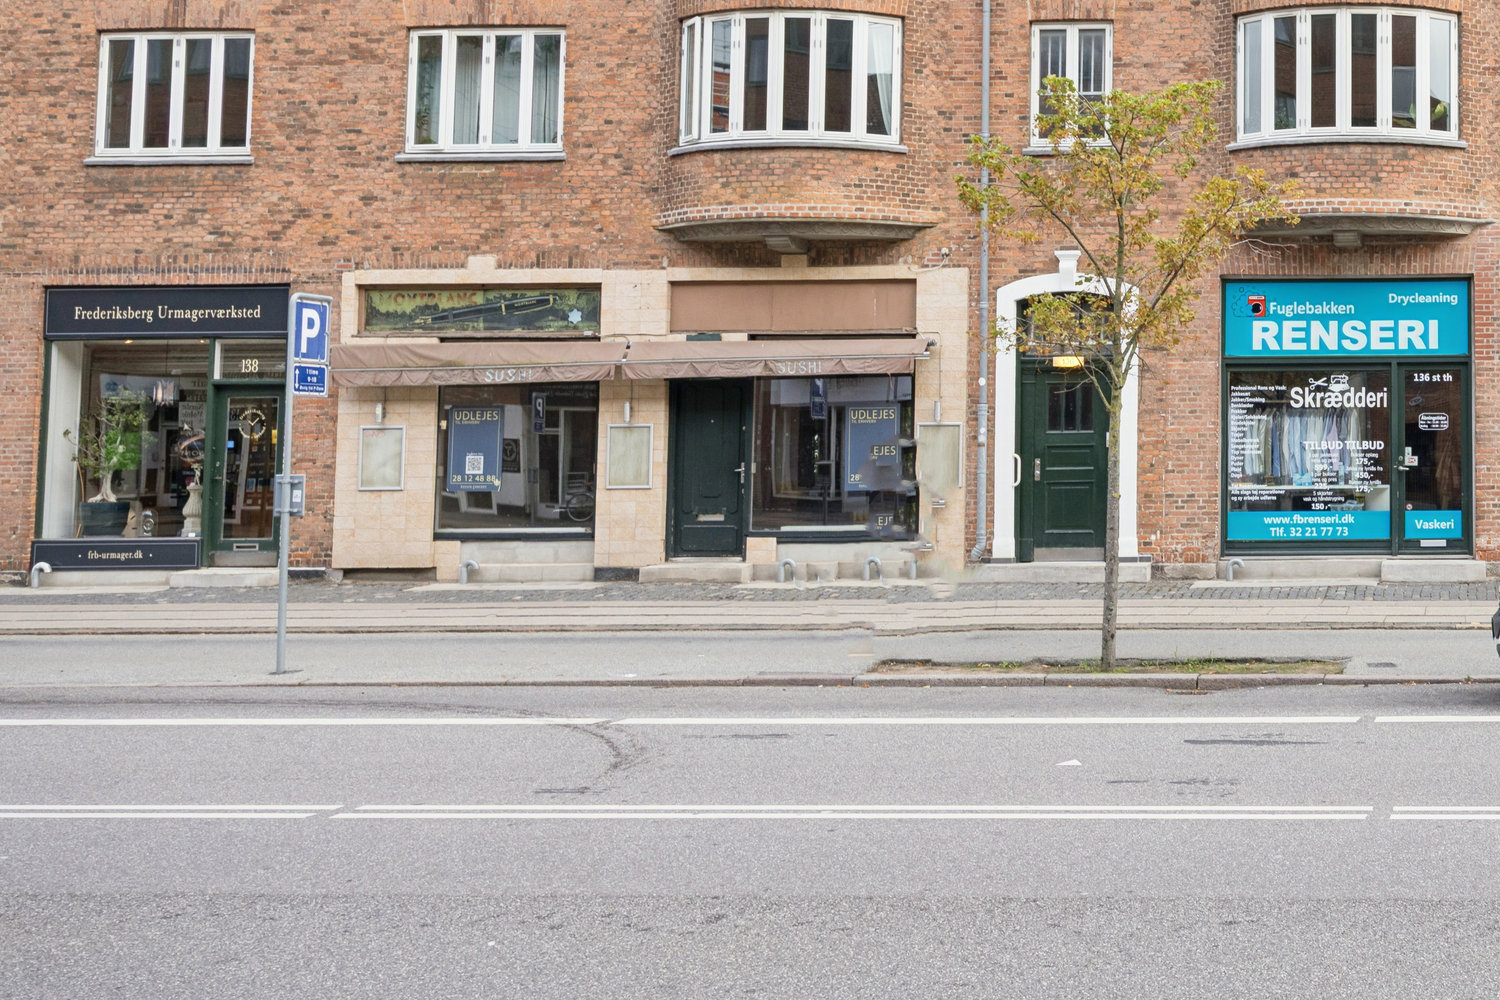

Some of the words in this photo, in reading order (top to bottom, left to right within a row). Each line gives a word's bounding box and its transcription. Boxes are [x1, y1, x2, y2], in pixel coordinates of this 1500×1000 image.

[1388, 293, 1458, 306] Drycleaning
[74, 306, 153, 323] Frederiksberg
[158, 305, 261, 322] Urmagerværksted
[1269, 302, 1355, 317] Fuglebakken
[301, 308, 320, 353] P
[1252, 320, 1438, 351] RENSERI
[241, 359, 259, 373] 138
[776, 360, 822, 374] SUSHI
[484, 369, 533, 383] SUSHI
[1413, 373, 1430, 382] 136
[1432, 374, 1441, 382] st
[1442, 373, 1453, 382] th
[1290, 386, 1388, 408] Skrædderi
[454, 410, 499, 420] UDLEJES
[850, 409, 895, 419] UDLEJES
[1303, 440, 1343, 450] TILBUD
[1344, 440, 1385, 450] TILBUD
[1355, 458, 1374, 466] 175,-
[1264, 514, 1355, 525] www.fbrenseri.dk
[1415, 519, 1454, 530] Vaskeri
[1270, 527, 1287, 537] Tlf.
[1289, 527, 1302, 537] 32
[1305, 527, 1317, 537] 21
[1320, 526, 1333, 537] 77
[1336, 526, 1349, 537] 73
[88, 550, 144, 561] frb-urmager.dk
